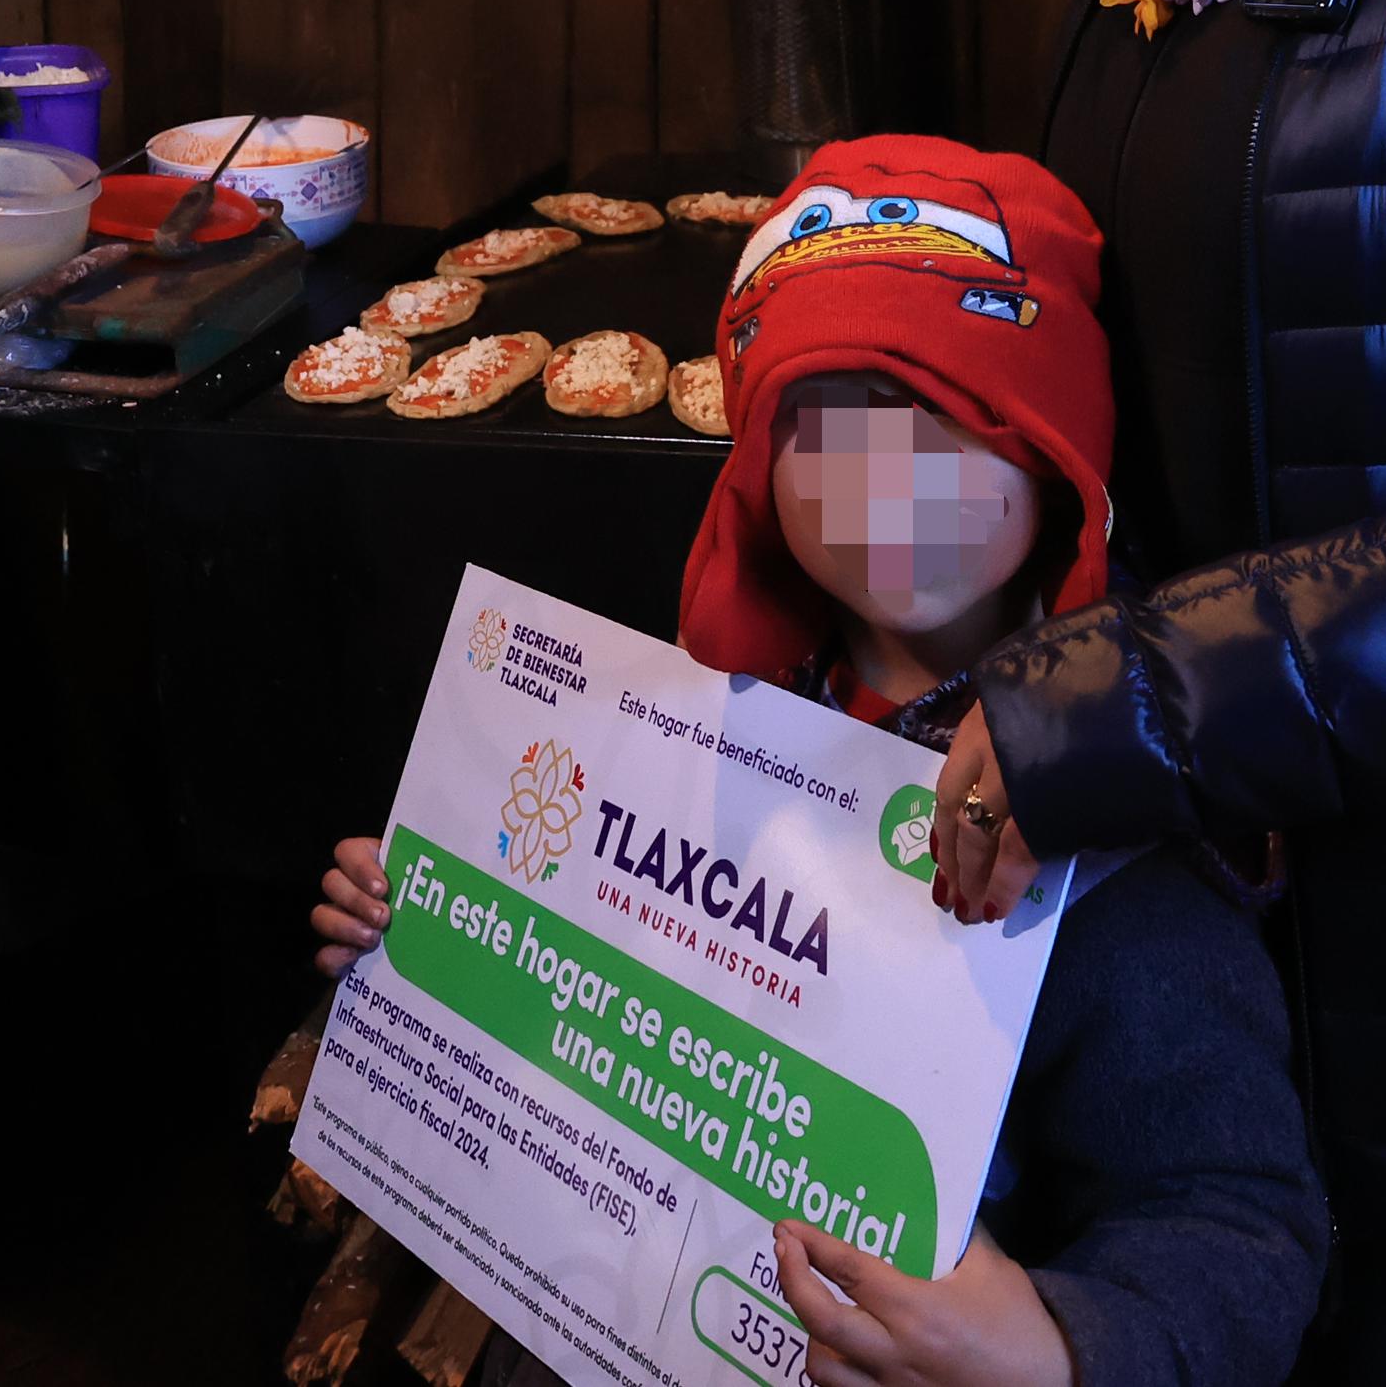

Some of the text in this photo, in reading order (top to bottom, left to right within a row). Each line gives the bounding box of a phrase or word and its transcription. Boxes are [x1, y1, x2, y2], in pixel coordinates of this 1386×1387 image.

[499, 665, 557, 708] TLAXCALA
[504, 644, 587, 694] DE BIENESTAR
[511, 622, 583, 668] SECRETARÍA
[618, 689, 859, 813] Este hogar fue beneficiado con el:
[593, 798, 828, 977] TLAXCALA
[596, 879, 801, 1009] UNA NUEVA HISTORIA
[394, 854, 812, 1138] ¡En este hogar se escribe
[322, 1036, 489, 1170] para el ejercicio fiscal 2024.
[334, 998, 637, 1237] Infraestructura Social para las Entidades (FISE),
[344, 963, 677, 1213] Este programa se realiza con recursos del Fondo de
[551, 1019, 906, 1269] una nueva historia!
[324, 1109, 358, 1140] programa
[389, 1158, 409, 1180] ajeno
[413, 1178, 447, 1209] cualquier
[443, 1202, 472, 1229] partido
[498, 1241, 525, 1271] Queda
[569, 1301, 586, 1320] uso
[583, 1313, 606, 1336] para
[605, 1325, 627, 1353] fines
[625, 1343, 662, 1380] distintos
[325, 1133, 336, 1151] los
[335, 1144, 362, 1172] recursos
[369, 1172, 385, 1190] este
[382, 1183, 418, 1217] programa
[416, 1208, 443, 1237] deberá
[441, 1230, 455, 1245] ser
[452, 1237, 495, 1279] denunciado
[499, 1276, 543, 1318] sancionado
[541, 1311, 561, 1333] ante
[560, 1322, 574, 1343] las
[572, 1336, 622, 1382] autoridades
